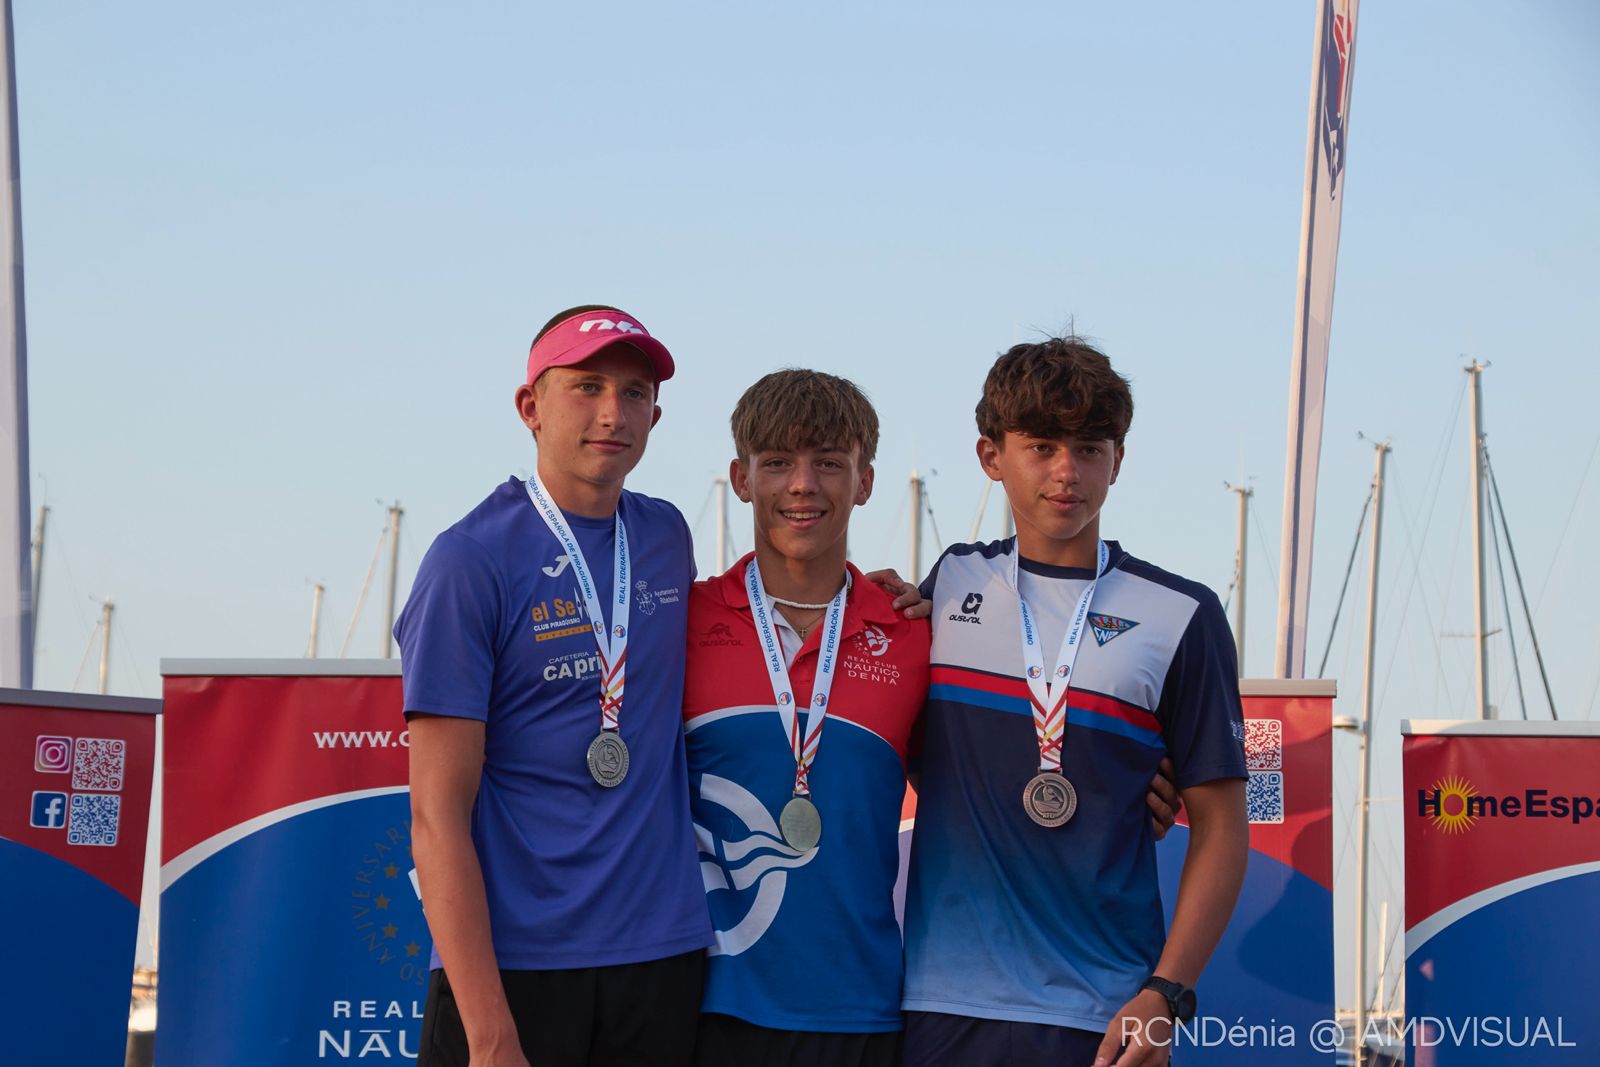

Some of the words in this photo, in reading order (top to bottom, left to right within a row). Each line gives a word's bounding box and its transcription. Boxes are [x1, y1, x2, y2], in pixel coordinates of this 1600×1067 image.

[567, 542, 576, 553] DE
[572, 553, 593, 600] PIRAGÜISMO
[618, 586, 627, 605] REAL
[532, 601, 550, 622] el
[533, 622, 550, 632] CLUB
[757, 605, 776, 653] FEDERACIÓN
[826, 607, 840, 654] FEDERACIÓN
[1068, 627, 1080, 645] REAL
[548, 651, 590, 665] CAFETERIA
[770, 654, 781, 673] REAL
[823, 655, 833, 674] REAL
[847, 654, 871, 664] REAL
[874, 660, 897, 670] CLUB
[847, 670, 897, 686] DENIA
[1417, 787, 1600, 825] HomeEsp
[333, 1000, 424, 1018] REAL
